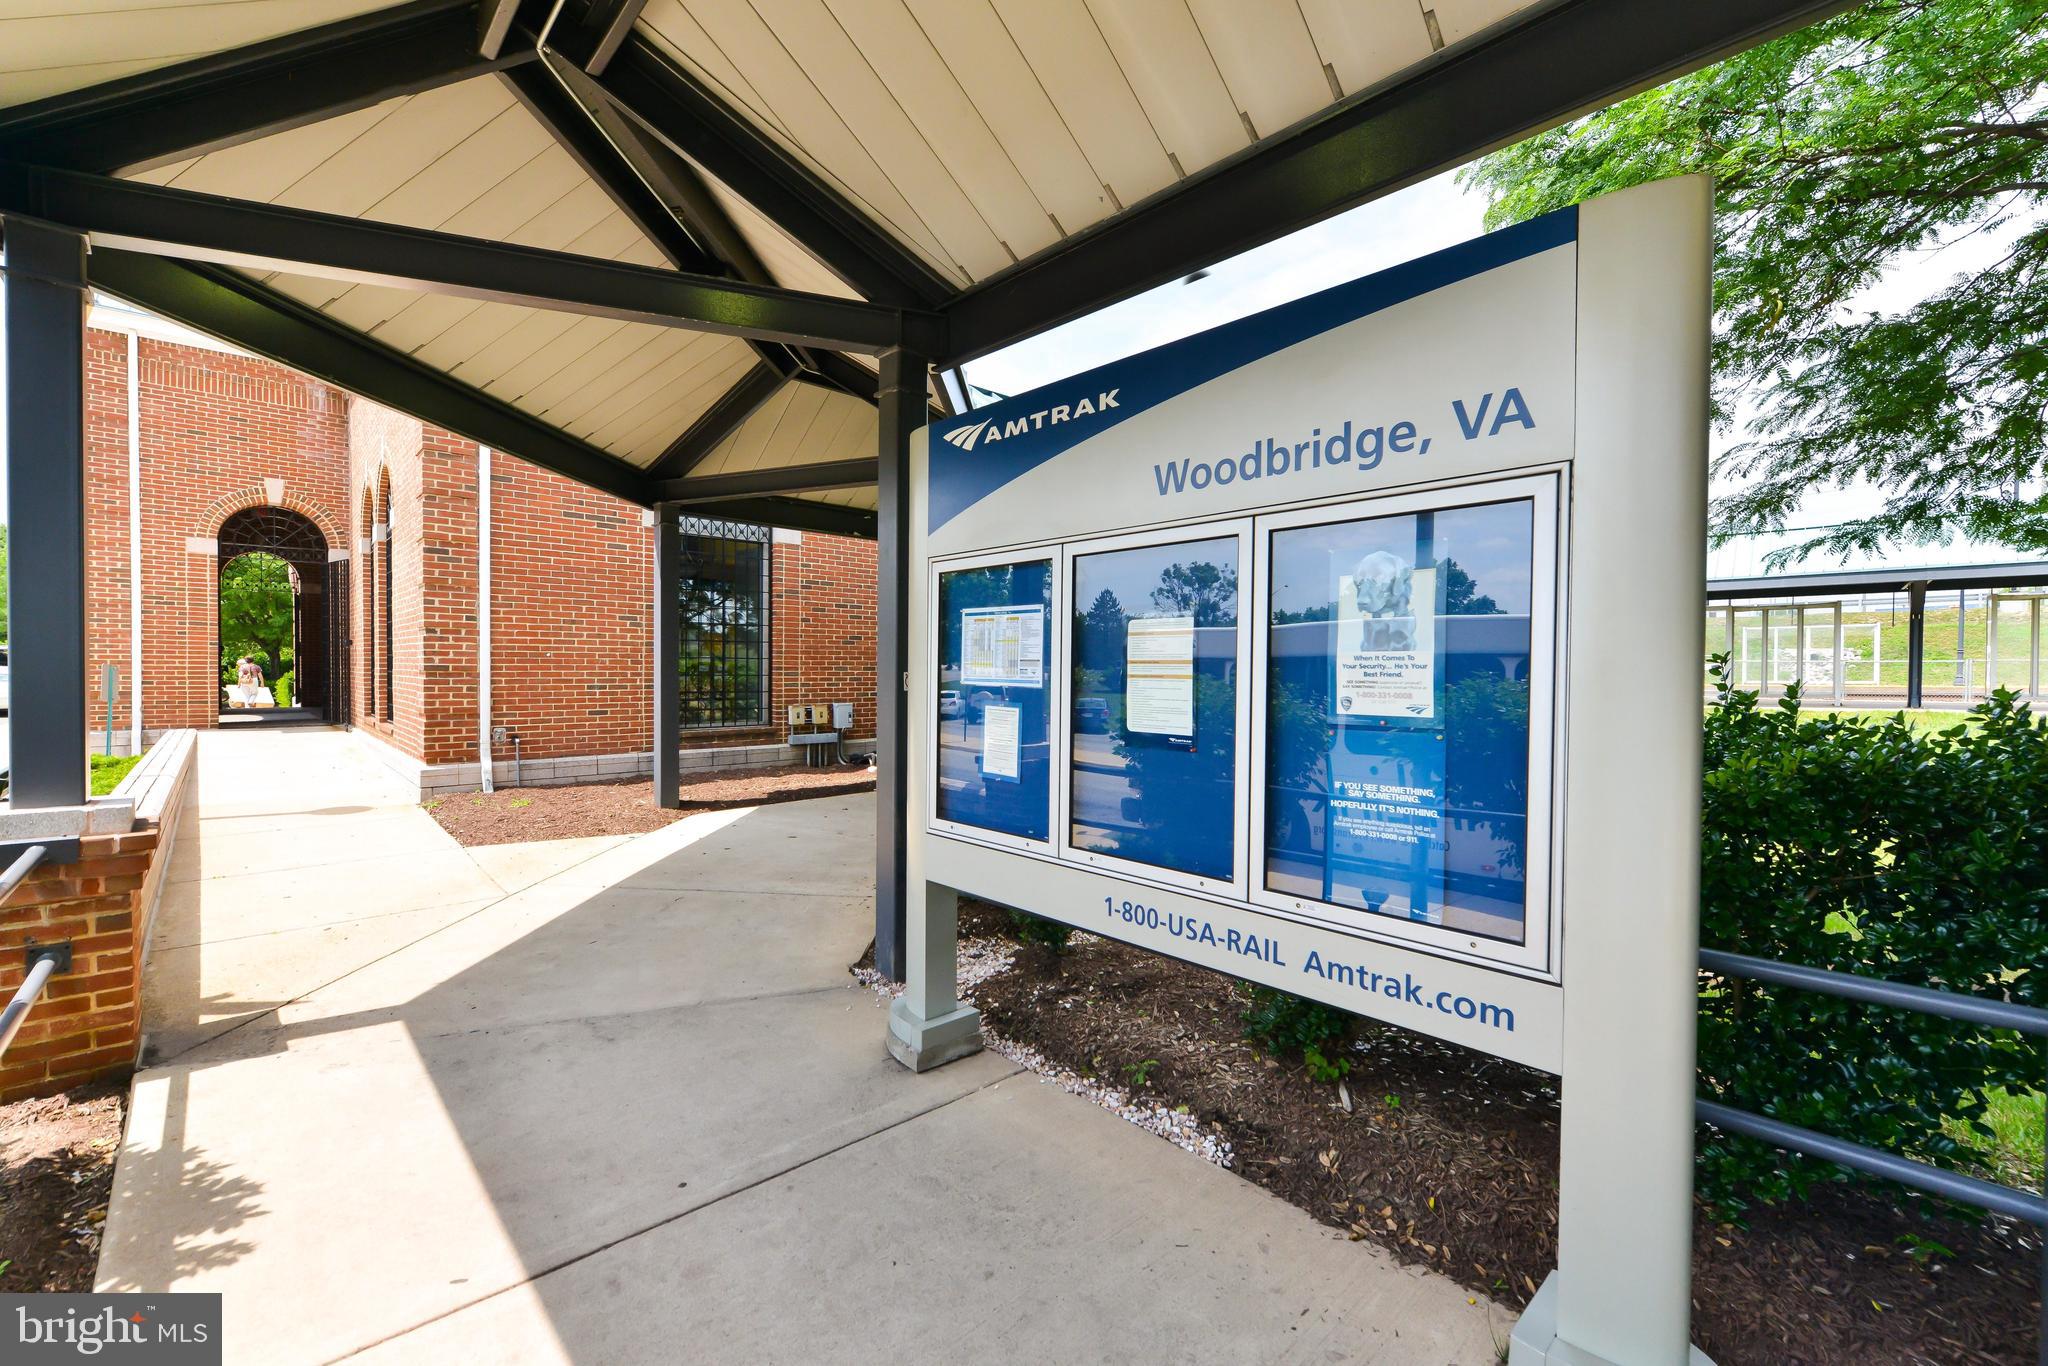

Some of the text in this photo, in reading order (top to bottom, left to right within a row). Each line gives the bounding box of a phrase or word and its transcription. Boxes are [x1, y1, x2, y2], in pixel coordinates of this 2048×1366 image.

[984, 388, 1121, 444] AMTRAK
[1154, 387, 1536, 496] Woodbridge, VA
[1331, 800, 1440, 818] HOPEFULLY, IT'S NOTHING.
[1366, 791, 1421, 803] SOMETHING.
[1380, 786, 1436, 798] SOMETHING,
[1104, 896, 1516, 1032] 1-800-USA-RAIL Amtrak.com
